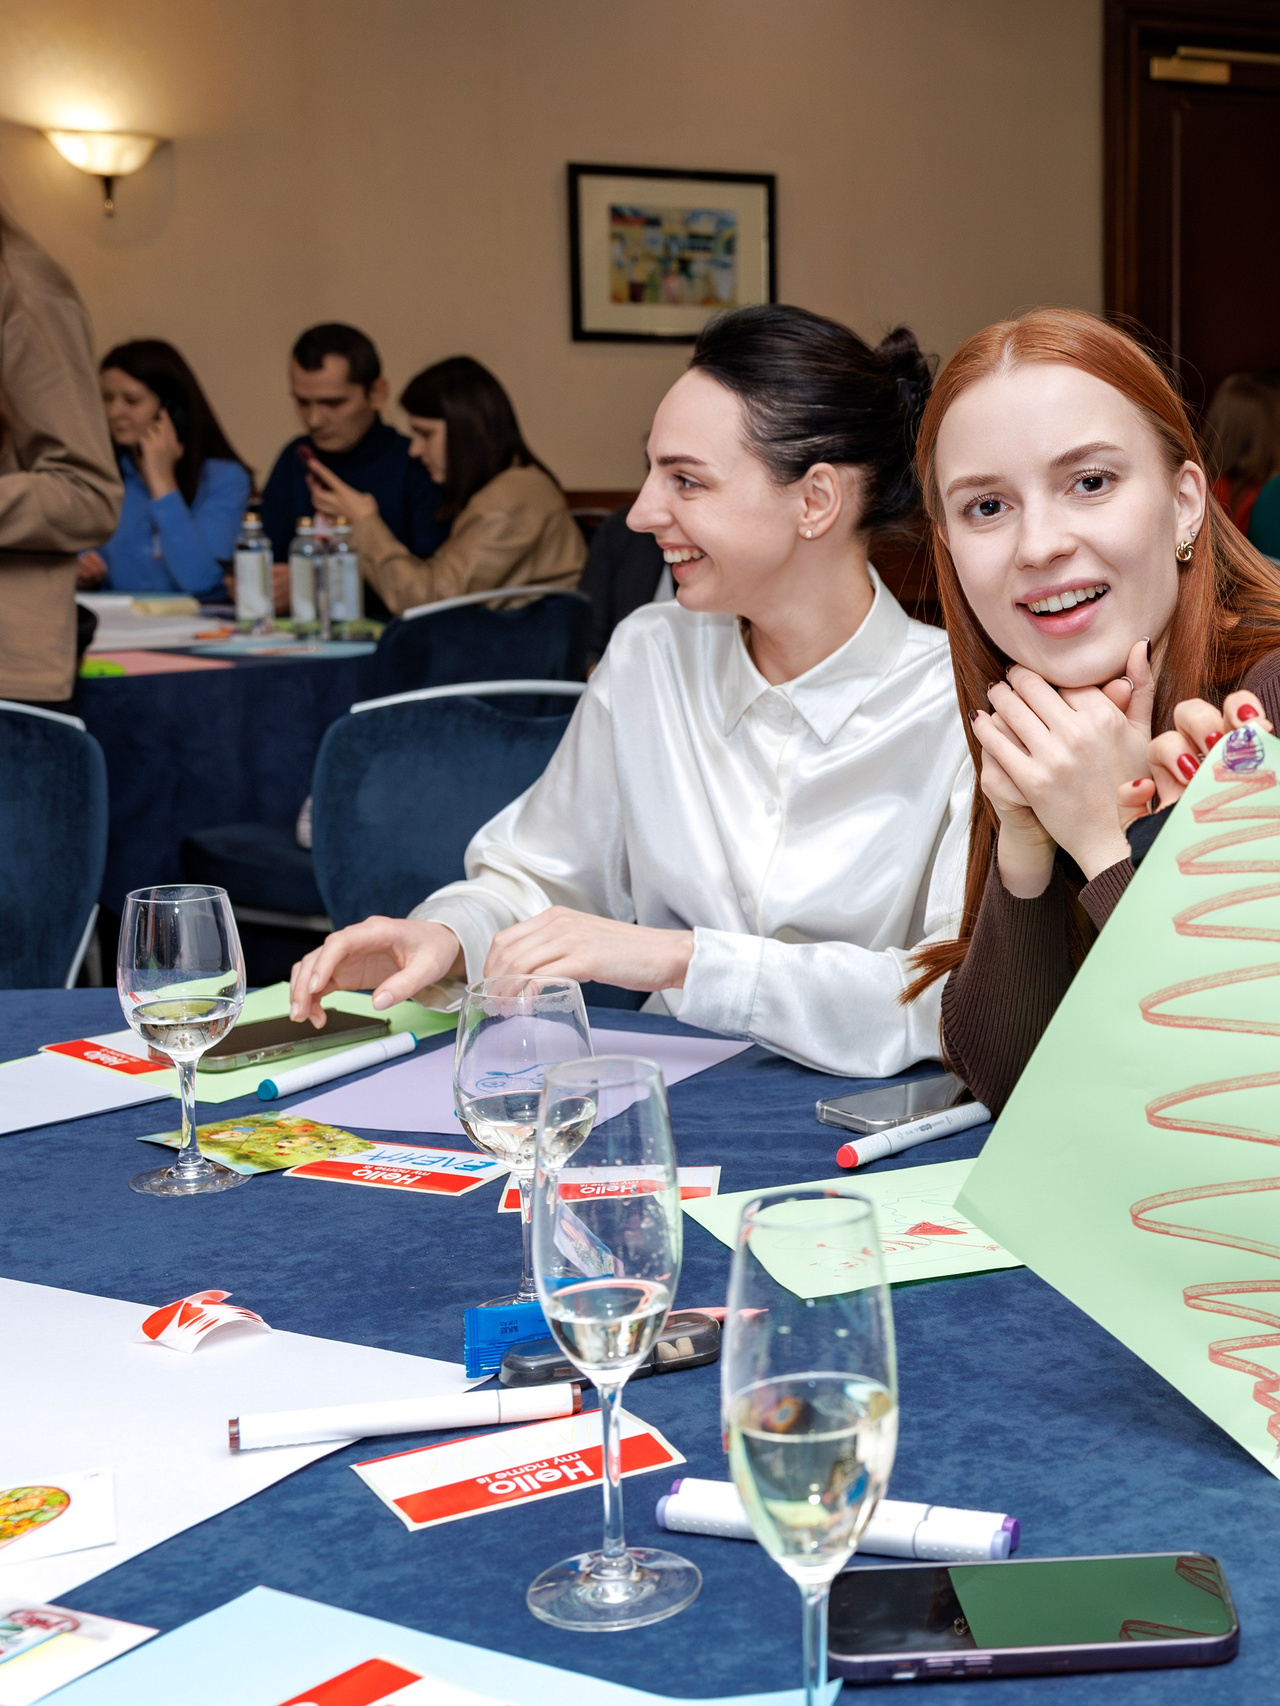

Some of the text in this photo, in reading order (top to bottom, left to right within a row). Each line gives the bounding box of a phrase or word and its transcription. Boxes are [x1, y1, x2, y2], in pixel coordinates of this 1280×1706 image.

[352, 1169, 422, 1185] Hello
[374, 1166, 410, 1174] name
[580, 1184, 637, 1195] Hello
[475, 1453, 581, 1485] my name is
[487, 1460, 595, 1495] Hello
